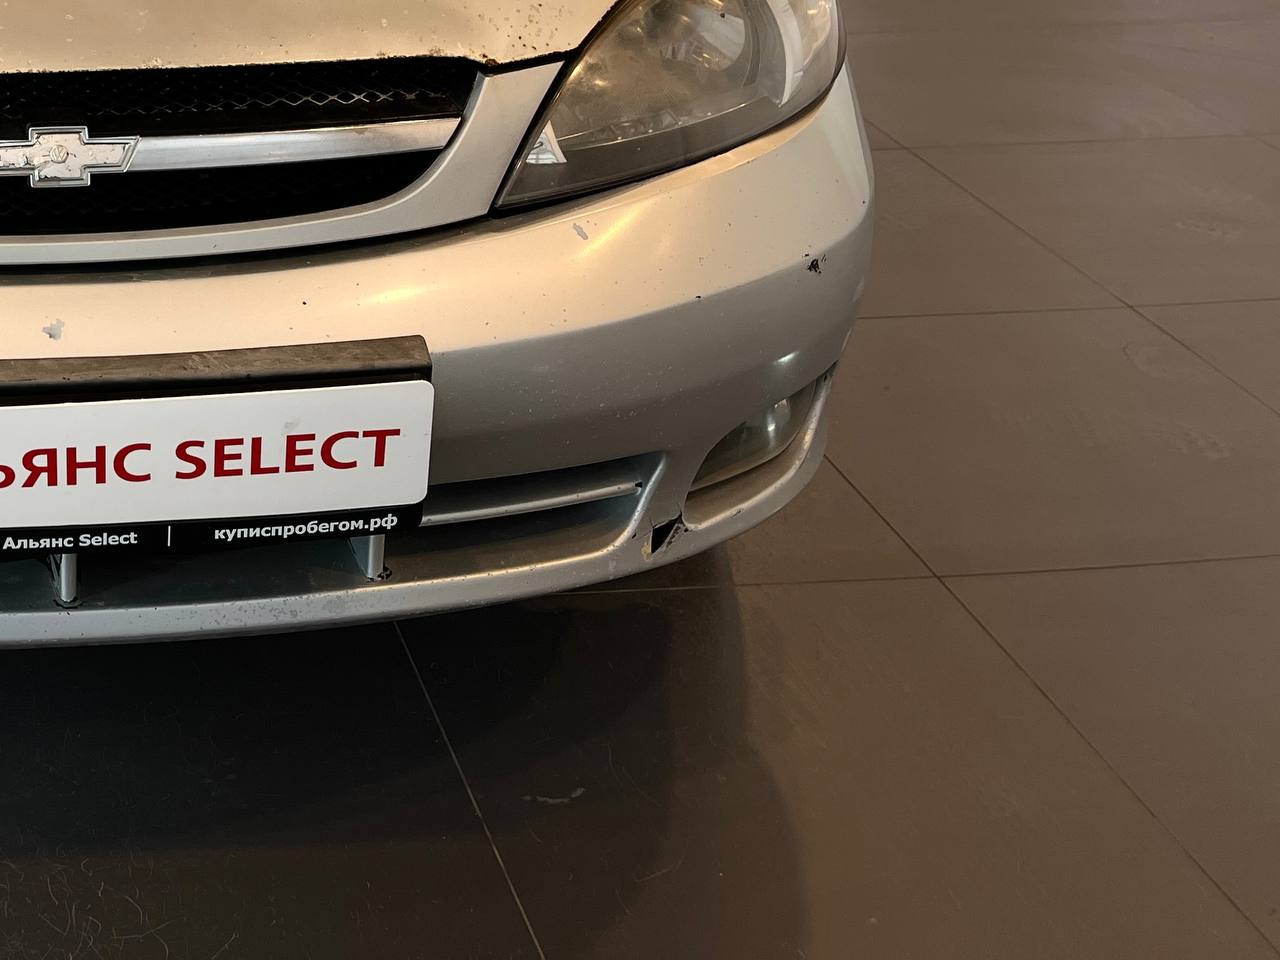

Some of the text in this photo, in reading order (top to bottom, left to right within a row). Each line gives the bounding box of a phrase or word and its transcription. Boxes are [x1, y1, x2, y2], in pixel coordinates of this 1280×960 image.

[175, 429, 401, 480] SELECT
[2, 532, 138, 550] Альянс Select
[214, 514, 398, 542] куписпробегом.рф
